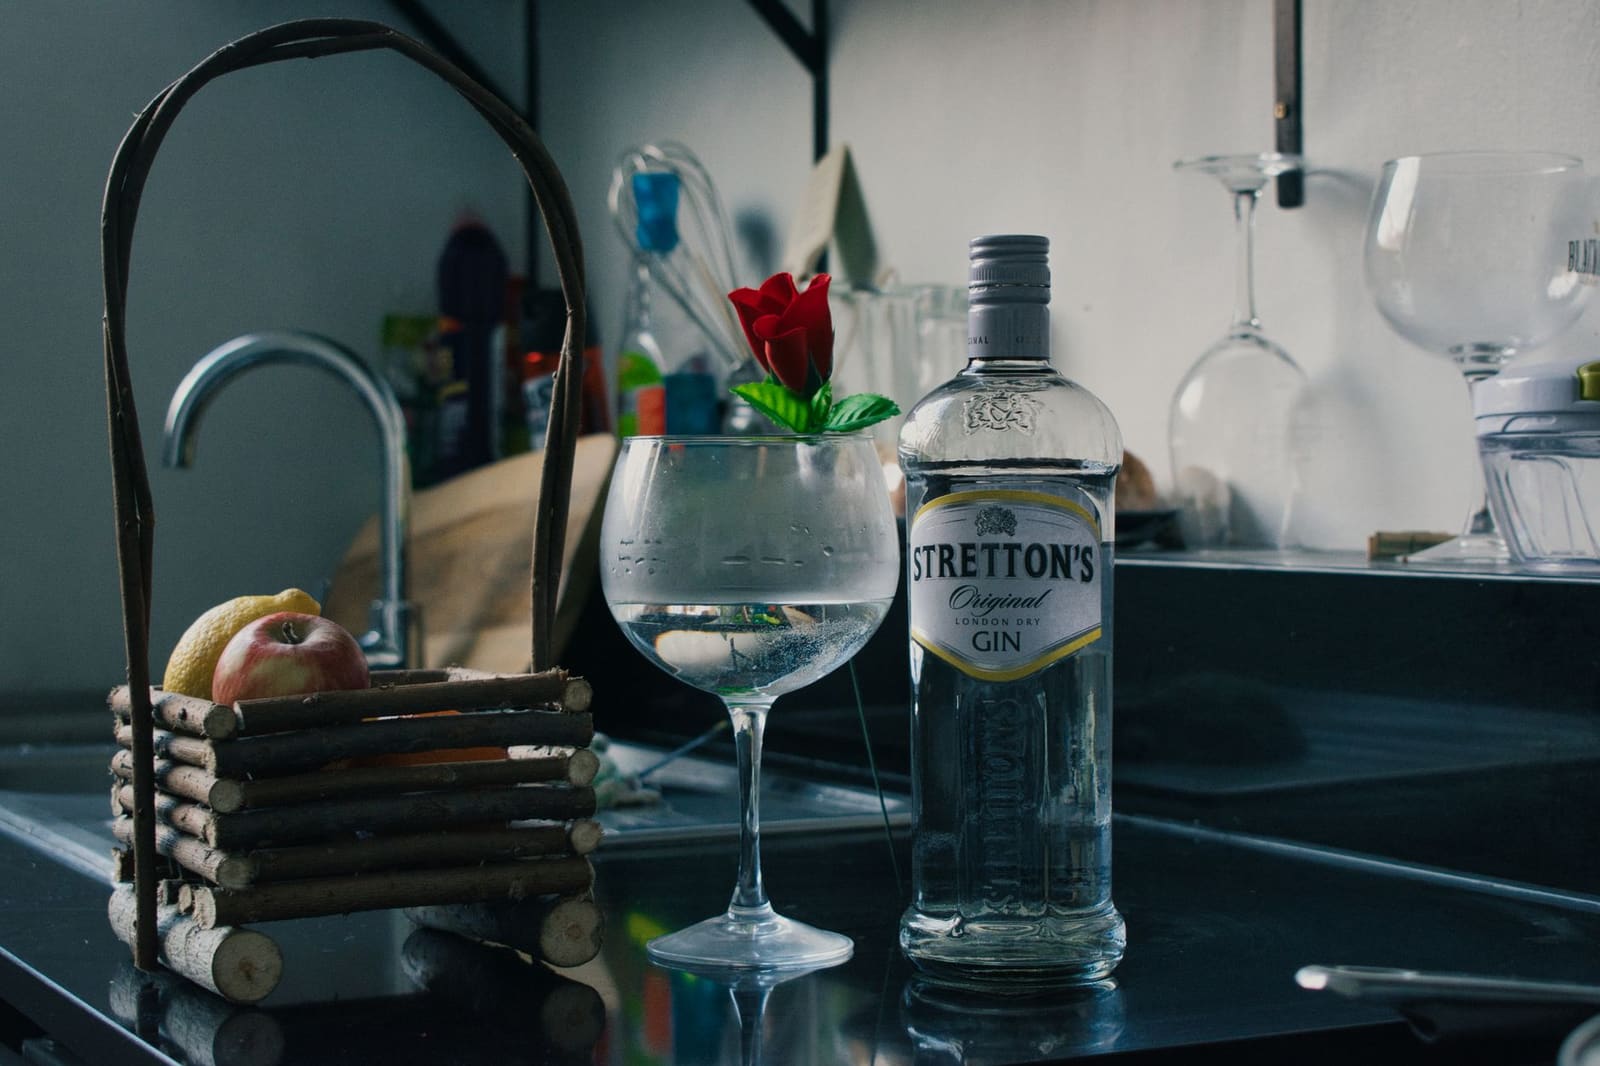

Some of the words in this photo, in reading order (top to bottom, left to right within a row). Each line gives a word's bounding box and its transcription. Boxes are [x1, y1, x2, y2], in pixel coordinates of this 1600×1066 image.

[913, 542, 1095, 583] STRETTON'S
[949, 584, 1052, 618] Original
[955, 617, 1009, 627] LONDON
[1016, 617, 1041, 627] DRY
[971, 630, 1021, 652] GIN
